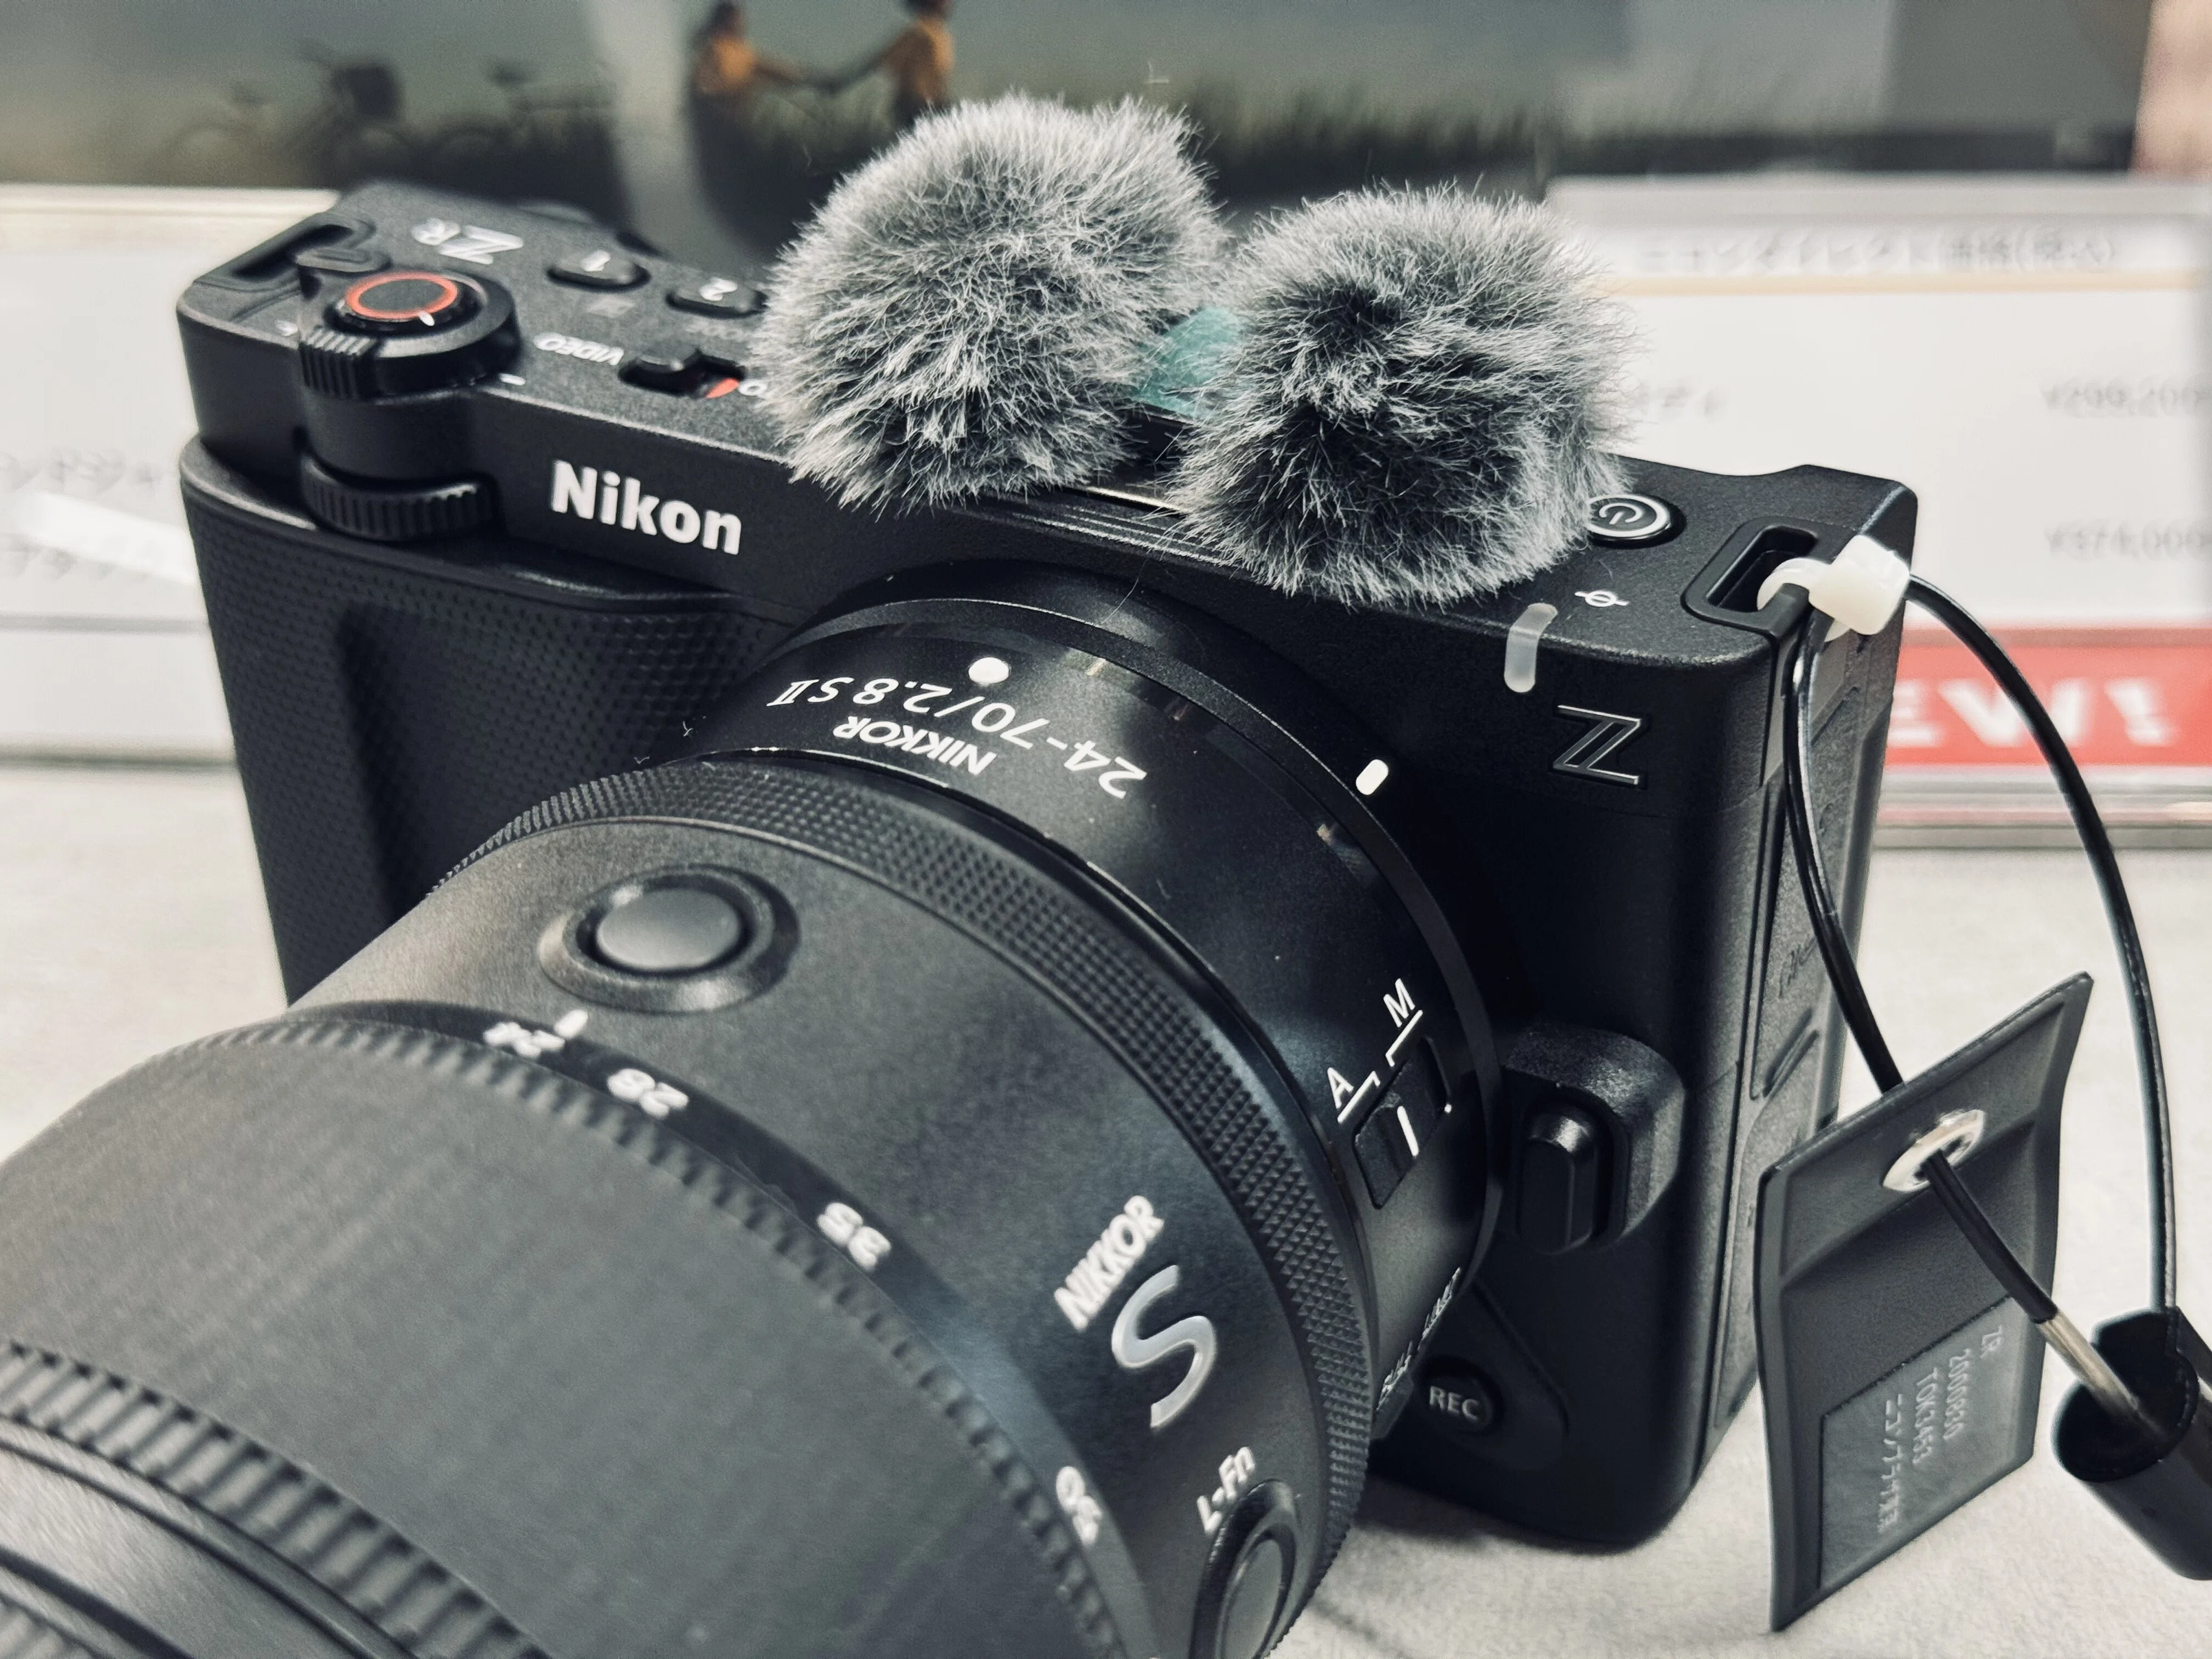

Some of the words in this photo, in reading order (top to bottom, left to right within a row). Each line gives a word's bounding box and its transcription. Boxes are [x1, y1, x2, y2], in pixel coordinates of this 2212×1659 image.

[534, 331, 624, 366] VIDEO
[551, 460, 742, 555] Nikon
[832, 715, 997, 776] NIKKOR
[852, 678, 1148, 799] 24-70/2.8
[1553, 704, 1641, 785] Z
[1383, 978, 1416, 1028] M
[1327, 1066, 1354, 1109] A
[1054, 1195, 1164, 1331] NIKKOR
[1111, 1264, 1218, 1429] S
[1980, 1323, 2004, 1358] ZR
[1429, 1386, 1480, 1422] REC
[1196, 1446, 1255, 1533] L-Fn
